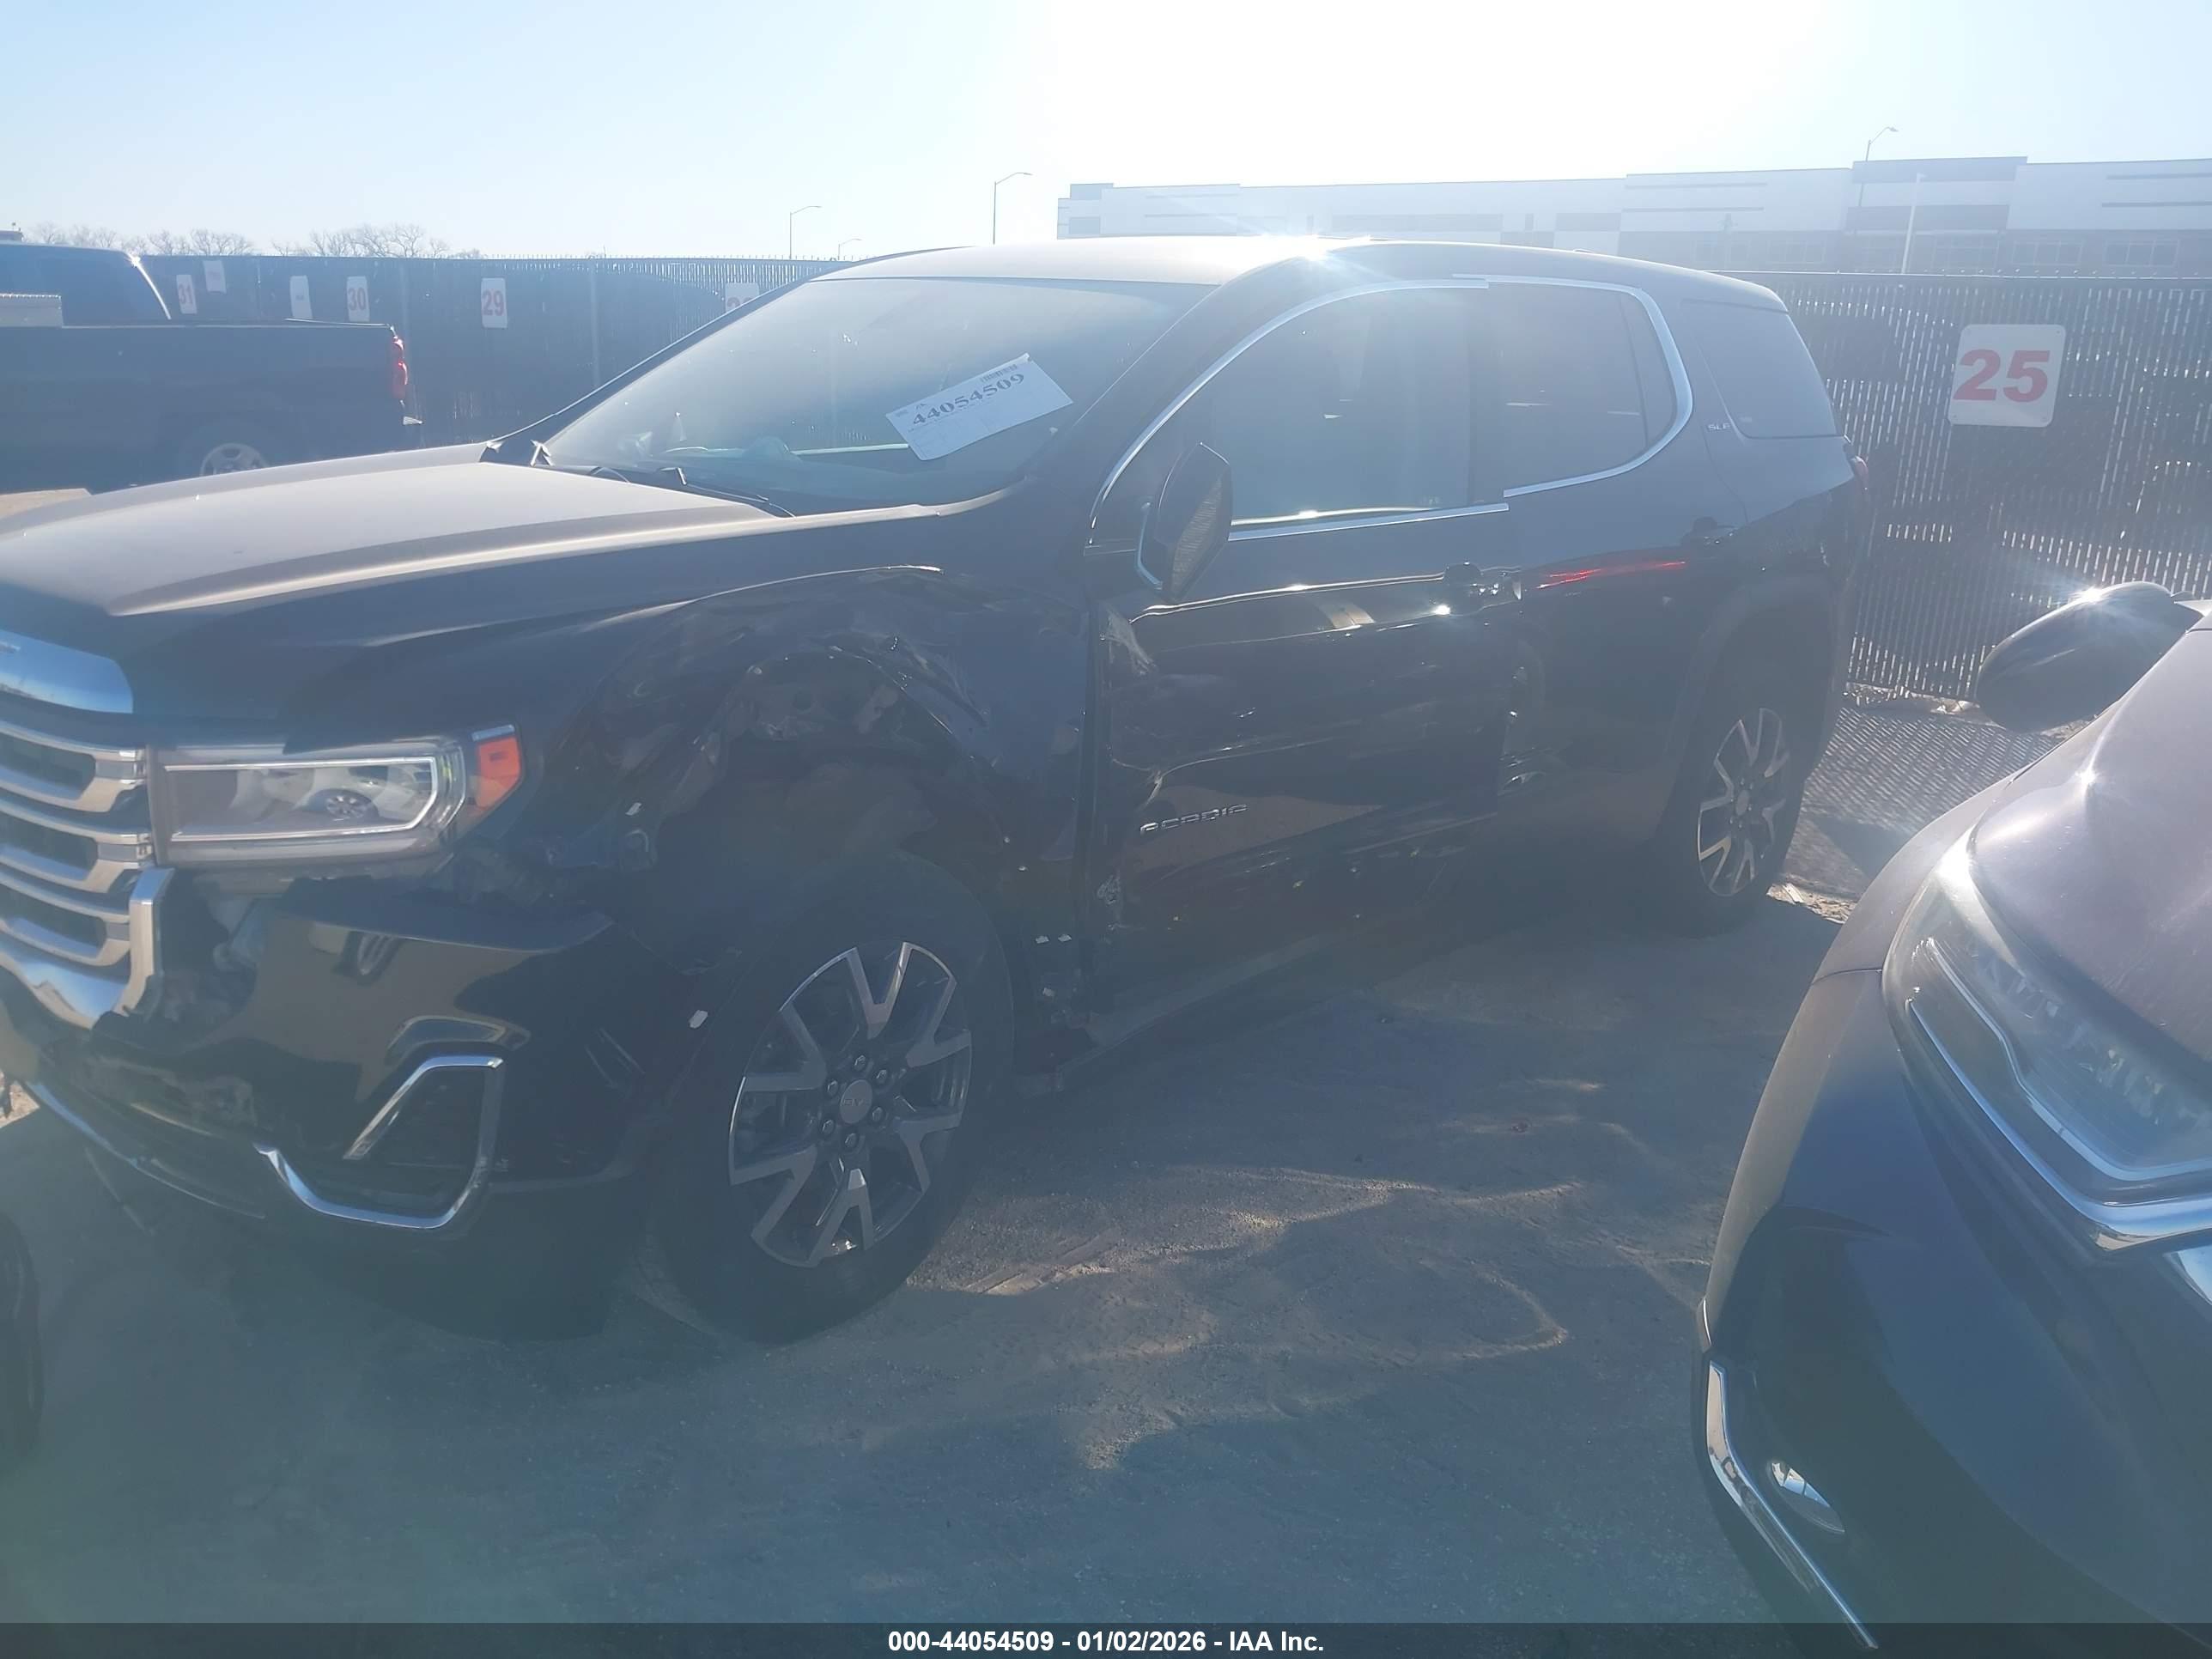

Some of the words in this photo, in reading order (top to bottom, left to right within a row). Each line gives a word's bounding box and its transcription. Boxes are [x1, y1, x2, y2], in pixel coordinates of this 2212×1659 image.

[178, 283, 193, 304] 31
[347, 287, 366, 311] 30
[481, 289, 505, 316] 29
[1953, 349, 2051, 403] 25
[913, 373, 1024, 425] 44054509
